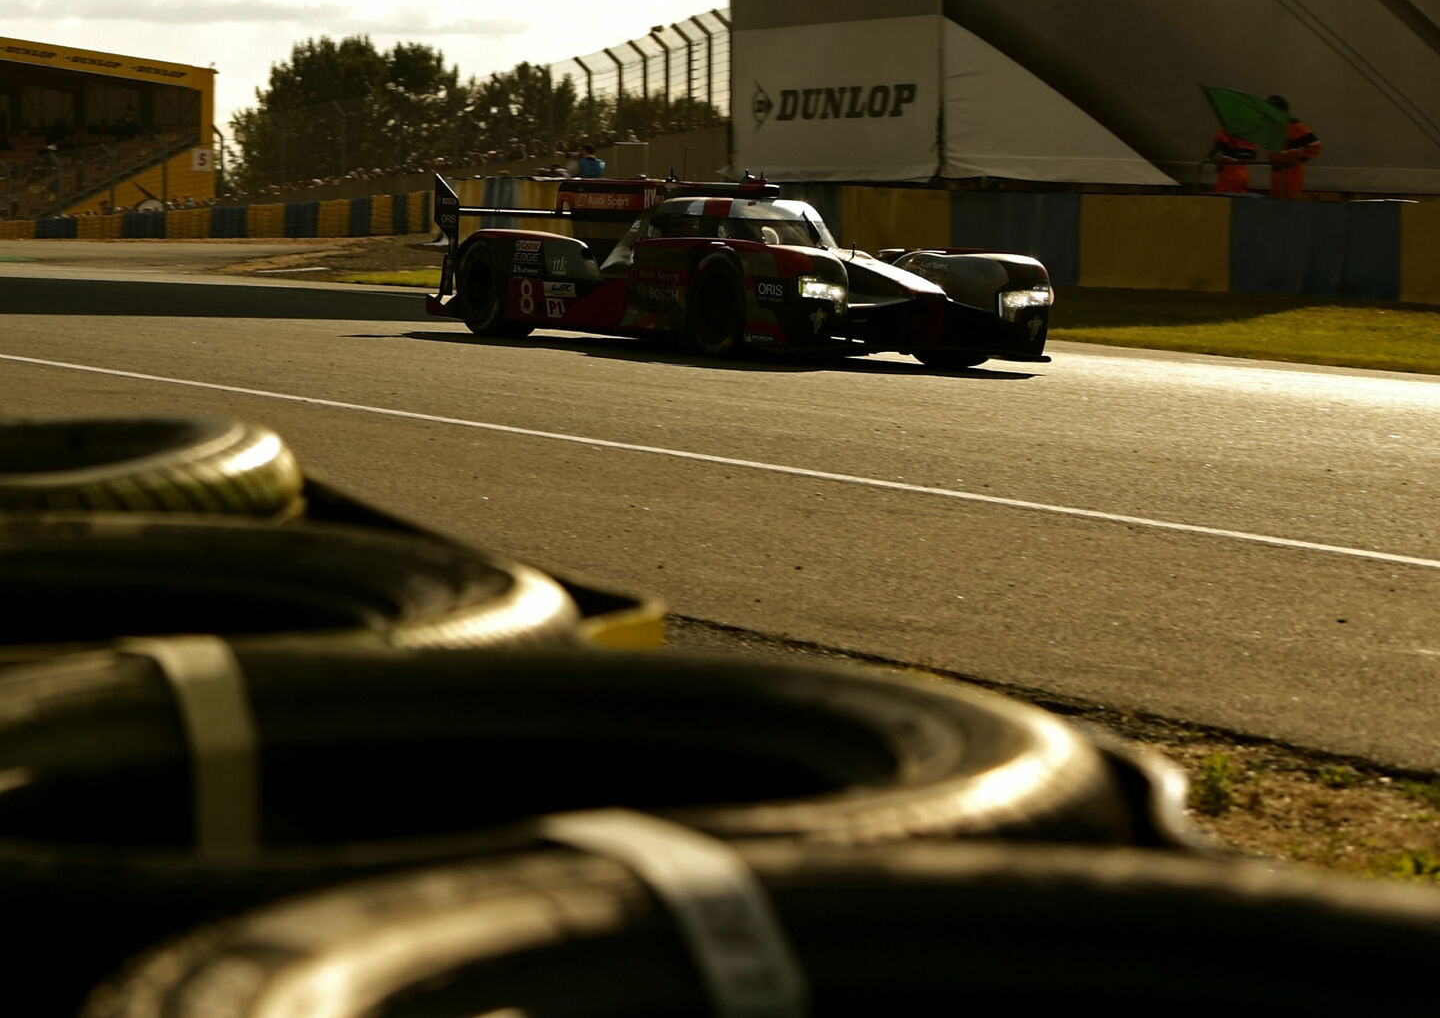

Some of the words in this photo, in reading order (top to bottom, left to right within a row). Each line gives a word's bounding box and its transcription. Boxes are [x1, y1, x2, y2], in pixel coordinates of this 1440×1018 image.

[6, 46, 57, 59] DUNLOP
[72, 55, 123, 69] DUNLOP
[137, 65, 188, 79] DUNLOP
[776, 83, 916, 121] DUNLOP
[586, 194, 606, 205] Audi
[607, 195, 630, 207] Sport
[520, 278, 535, 315] 8
[758, 282, 784, 297] ORIS
[549, 299, 562, 315] P1
